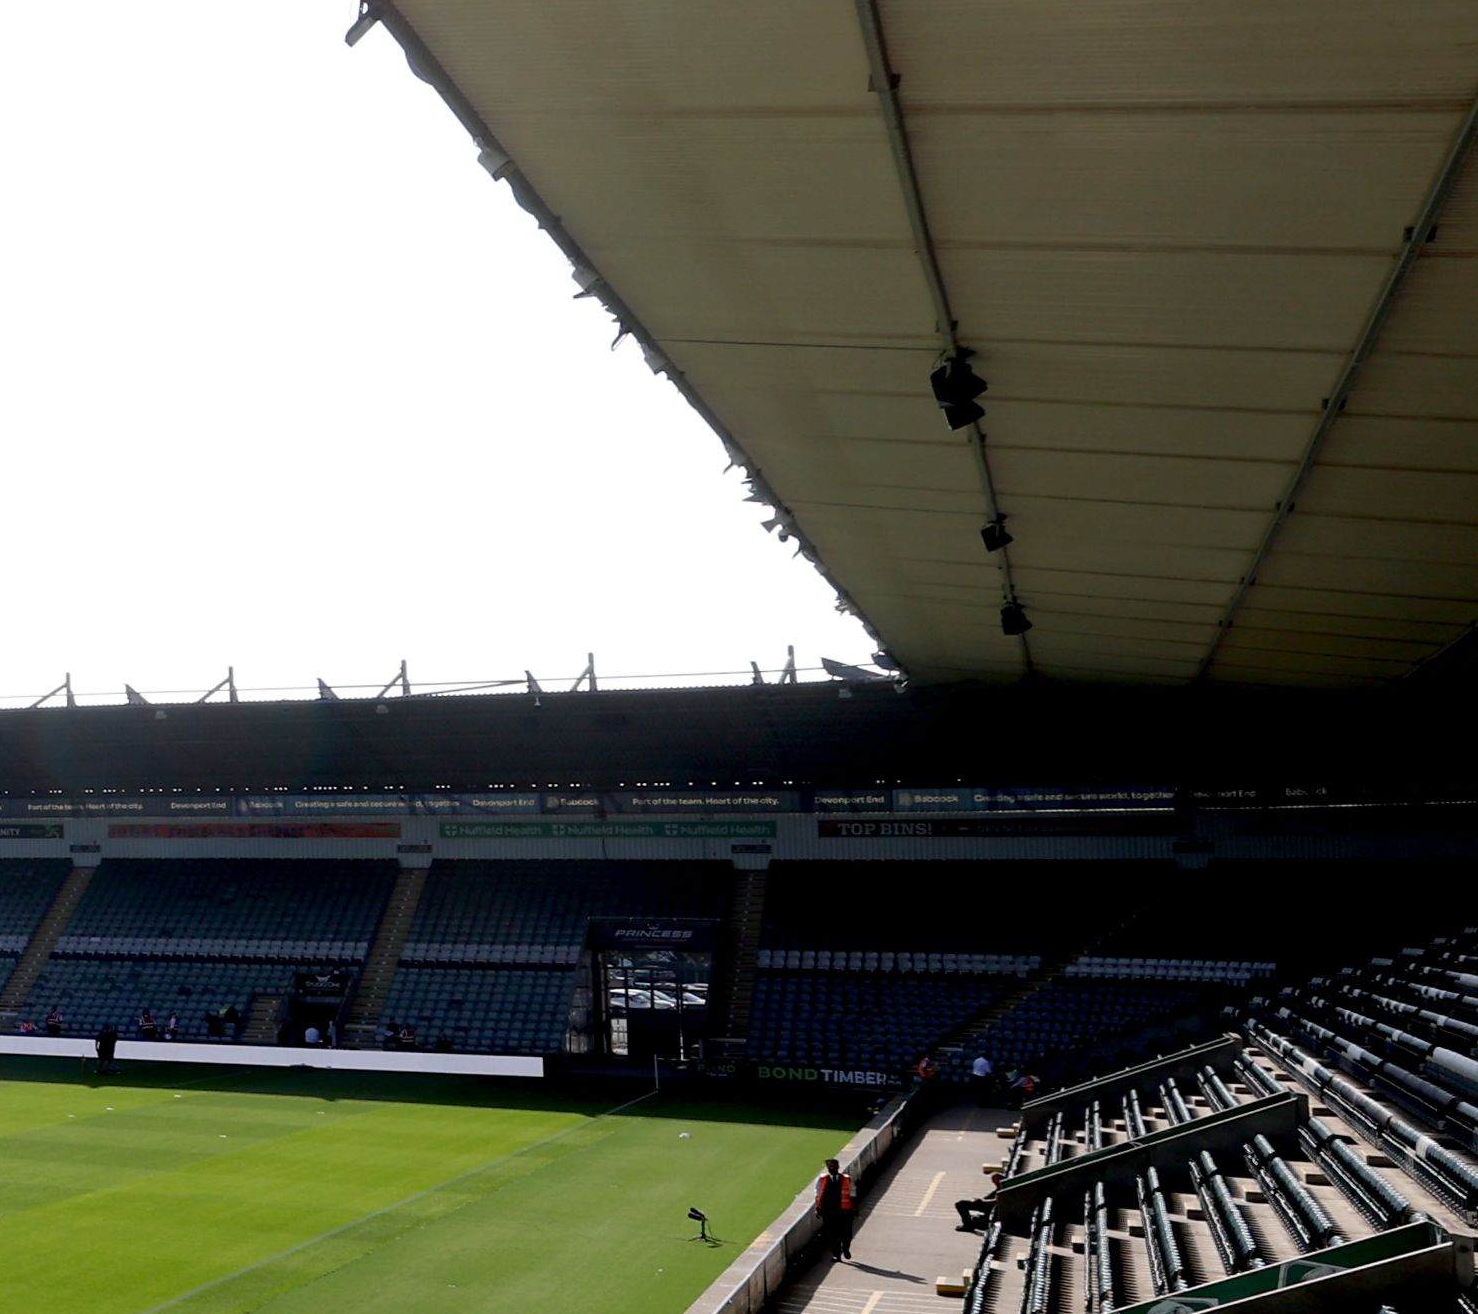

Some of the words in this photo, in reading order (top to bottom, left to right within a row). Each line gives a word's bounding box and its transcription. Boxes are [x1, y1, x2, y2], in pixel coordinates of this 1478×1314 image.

[560, 798, 598, 806] Babcock
[632, 797, 651, 805] Part
[653, 797, 661, 805] of
[662, 797, 677, 805] the
[679, 797, 704, 805] team.
[706, 797, 729, 805] Heart
[730, 797, 741, 805] of
[743, 797, 758, 805] the
[759, 797, 779, 806] city.
[815, 795, 864, 804] Devonport
[865, 795, 884, 803] End
[915, 794, 958, 803] Babcock
[1099, 792, 1130, 801] world,
[1132, 791, 1174, 801] together
[171, 802, 210, 810] Devonport
[459, 825, 503, 835] Nuffield
[506, 825, 541, 835] Health
[567, 825, 612, 835] Nuffield
[616, 825, 653, 835] Health
[680, 825, 727, 835] Nuffield
[729, 825, 771, 835] Health
[837, 823, 876, 835] TOP
[881, 823, 933, 835] BINS!
[615, 929, 693, 938] PRINCESS
[758, 1067, 819, 1081] BOND
[821, 1068, 888, 1085] TIMBER
